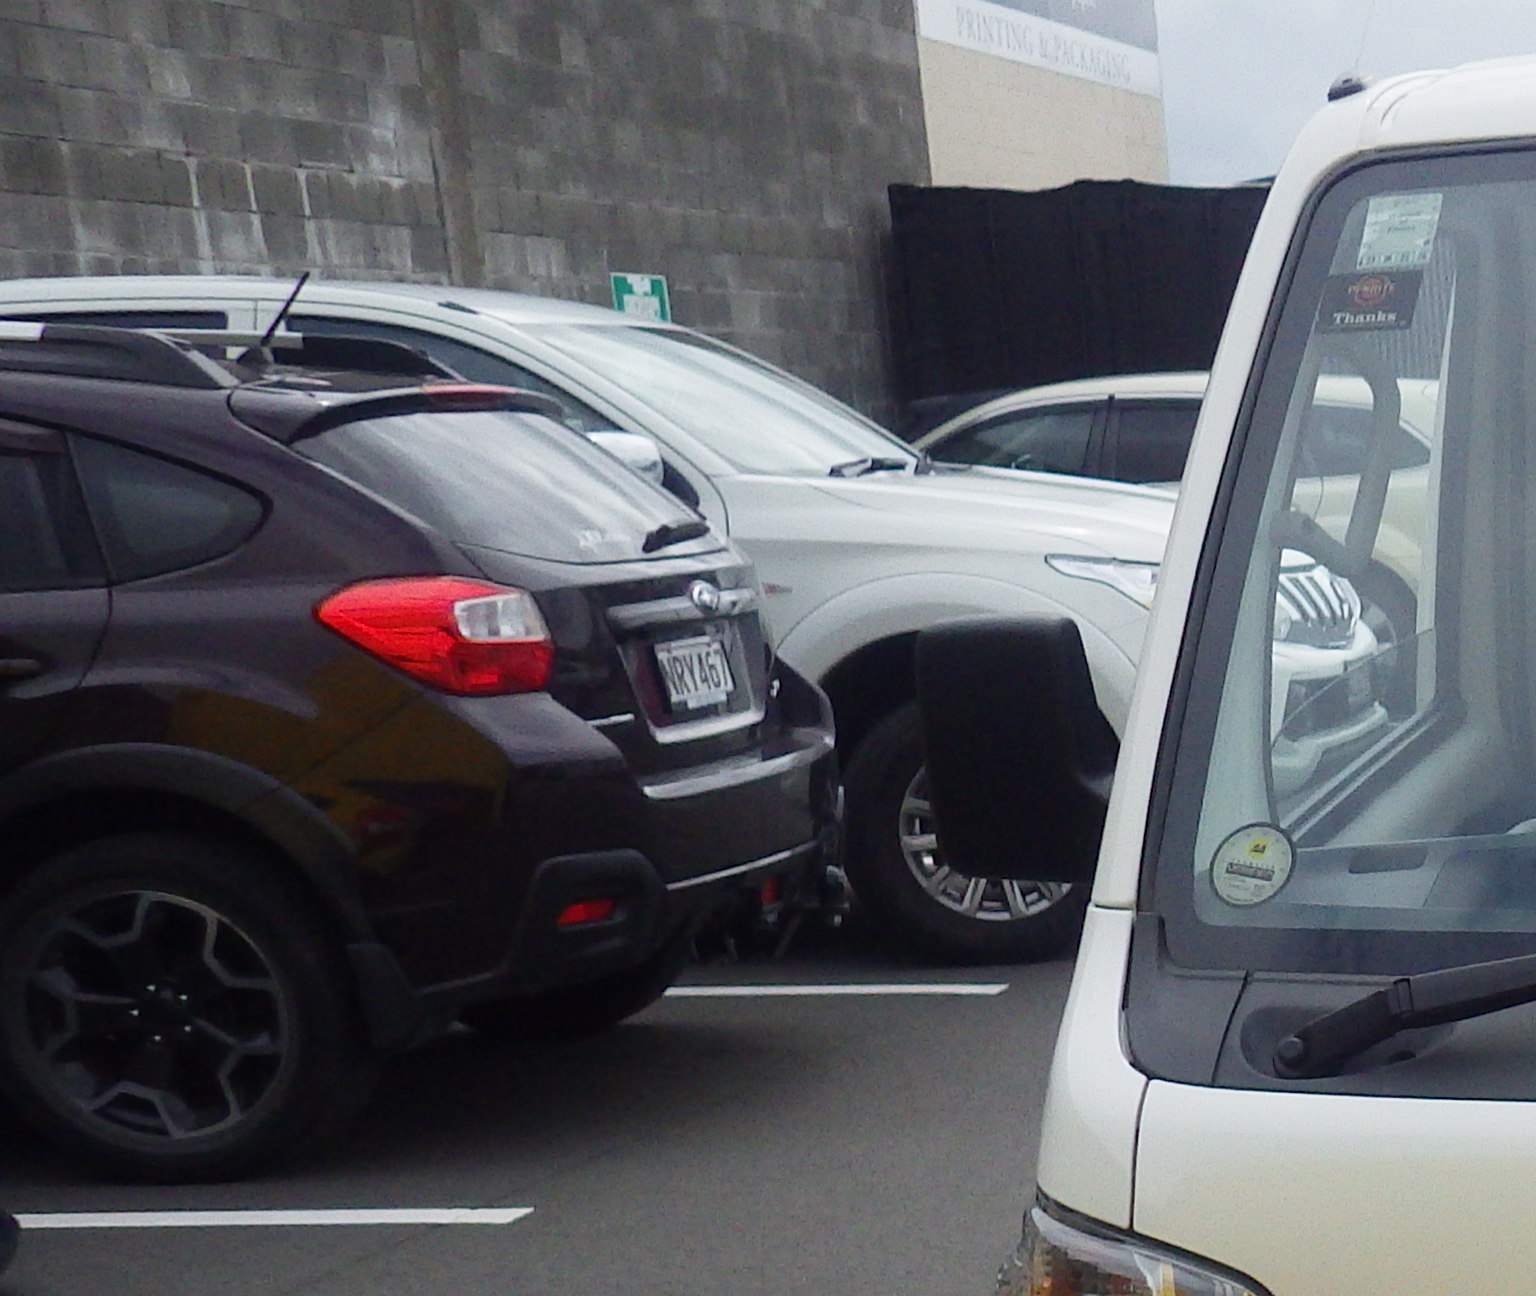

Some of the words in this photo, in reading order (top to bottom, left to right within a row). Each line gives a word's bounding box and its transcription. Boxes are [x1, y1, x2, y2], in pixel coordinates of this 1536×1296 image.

[955, 6, 1034, 55] PRINTING
[1054, 37, 1131, 82] PACKAGING
[1332, 310, 1398, 324] Thanks
[661, 649, 729, 695] NRY467
